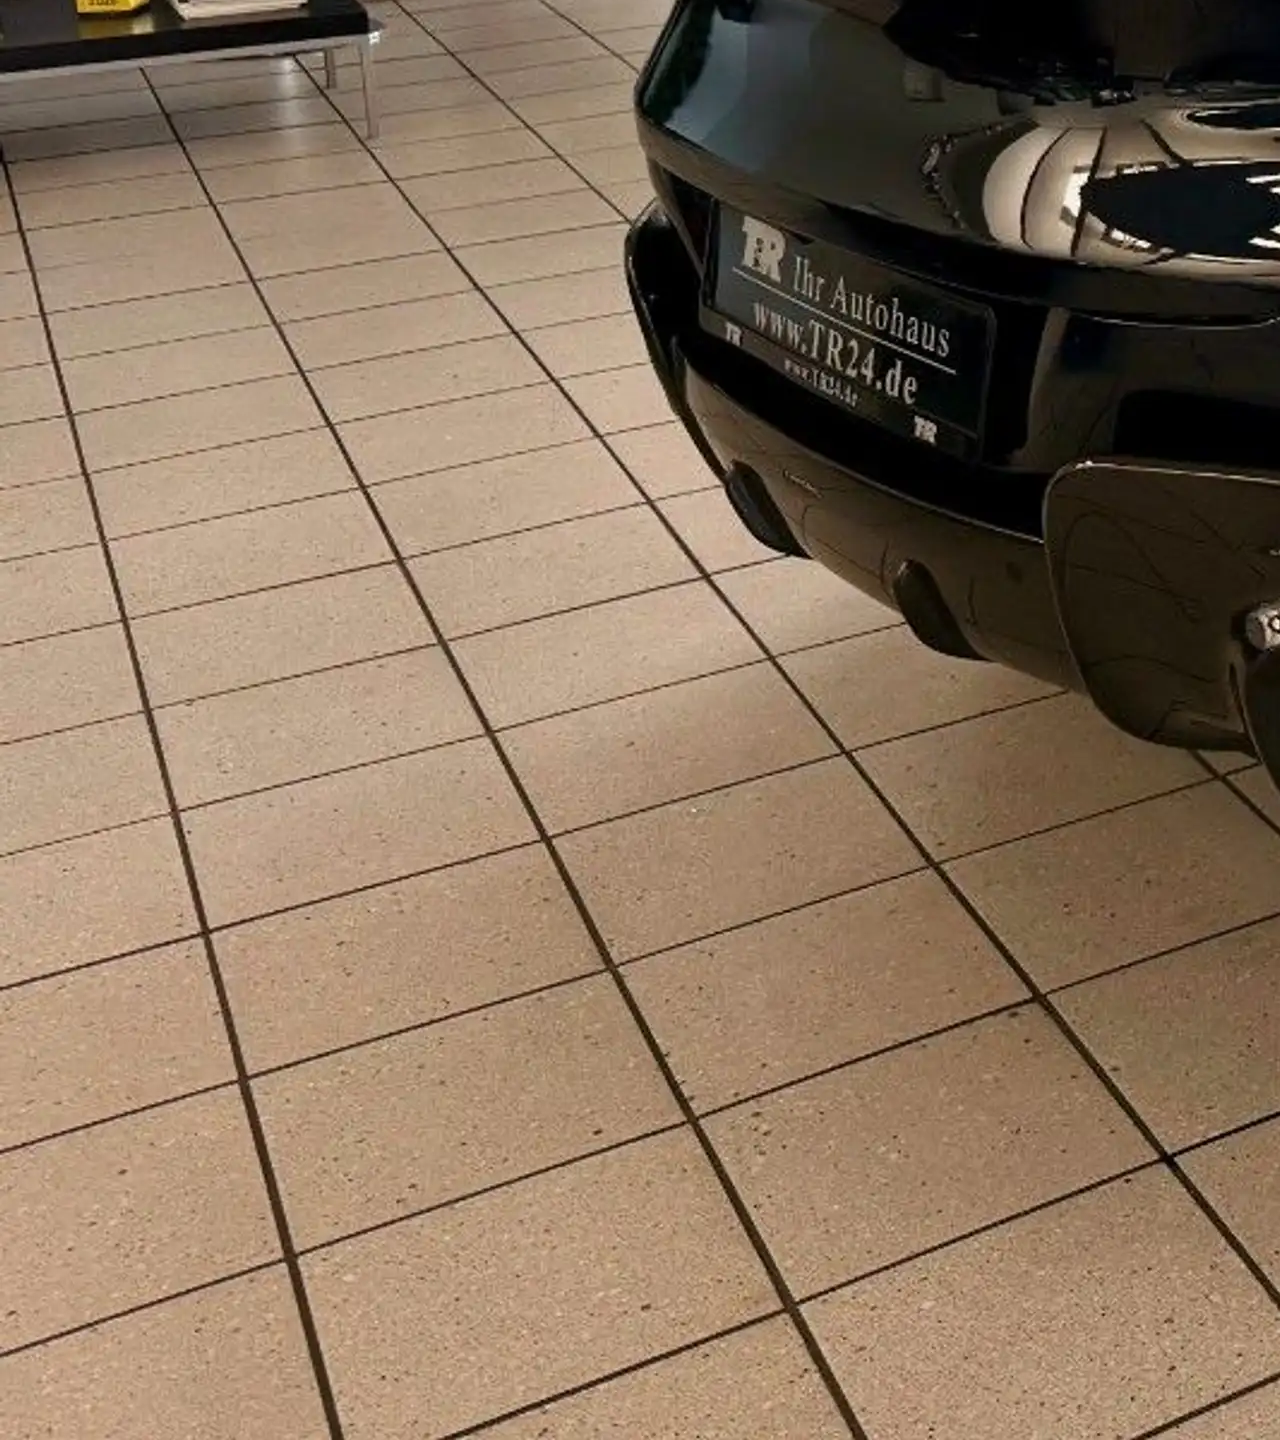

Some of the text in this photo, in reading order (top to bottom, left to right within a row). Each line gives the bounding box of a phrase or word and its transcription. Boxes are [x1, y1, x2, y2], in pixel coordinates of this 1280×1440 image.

[753, 302, 918, 405] www.TR24.de
[793, 255, 825, 303] Ihr
[831, 275, 950, 358] Autohaus
